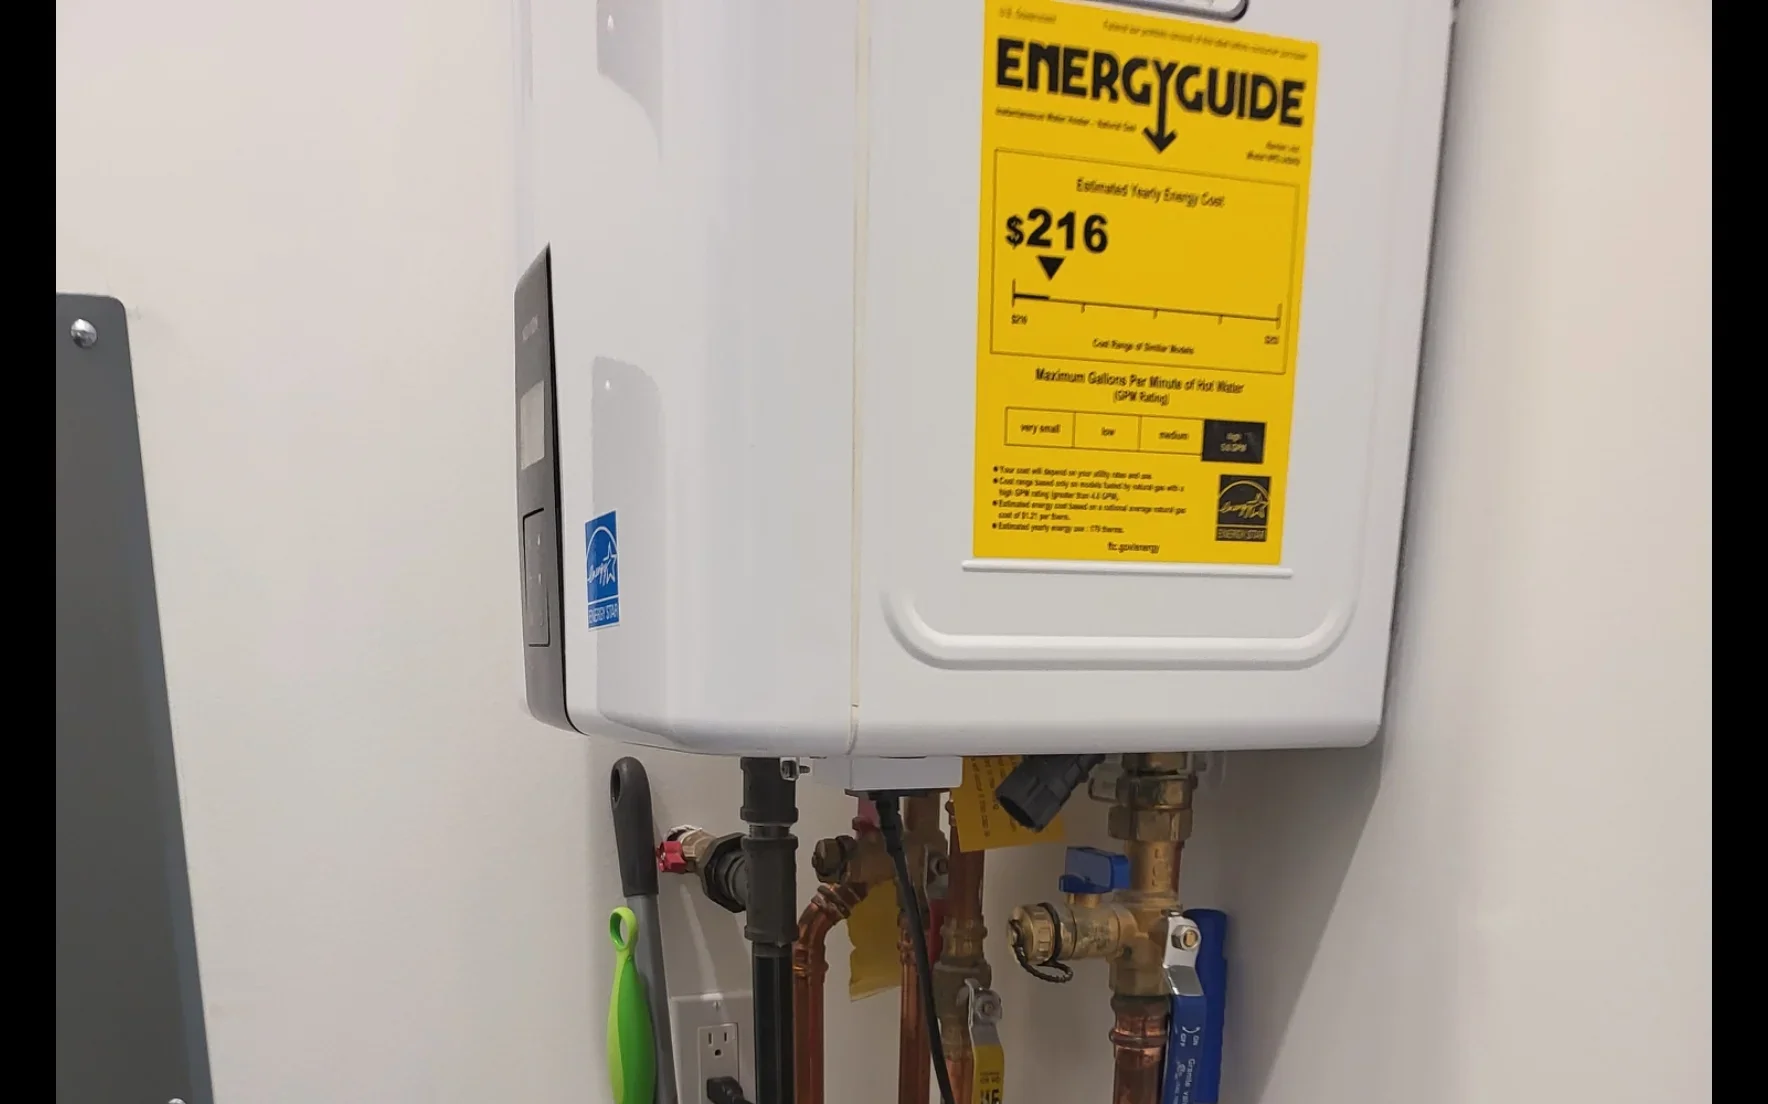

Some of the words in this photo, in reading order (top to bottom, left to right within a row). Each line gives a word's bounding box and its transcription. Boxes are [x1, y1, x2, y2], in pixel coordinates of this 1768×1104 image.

[997, 37, 1305, 127] ENERGYGUIDE
[1076, 178, 1128, 197] Estimated
[1130, 182, 1161, 204] Yearly
[1163, 186, 1199, 208] Energy
[1200, 191, 1225, 208] Cost
[1005, 206, 1109, 254] $216
[1035, 368, 1085, 383] Maximum
[1088, 371, 1126, 386] Gallons
[1129, 374, 1147, 387] Per
[1150, 375, 1182, 390] Minute
[1184, 378, 1196, 390] of
[1197, 378, 1213, 391] Hot
[1215, 380, 1245, 393] Water
[1020, 423, 1037, 435] very
[1039, 423, 1061, 434] small
[1101, 427, 1116, 437] low
[1158, 431, 1189, 441] medium
